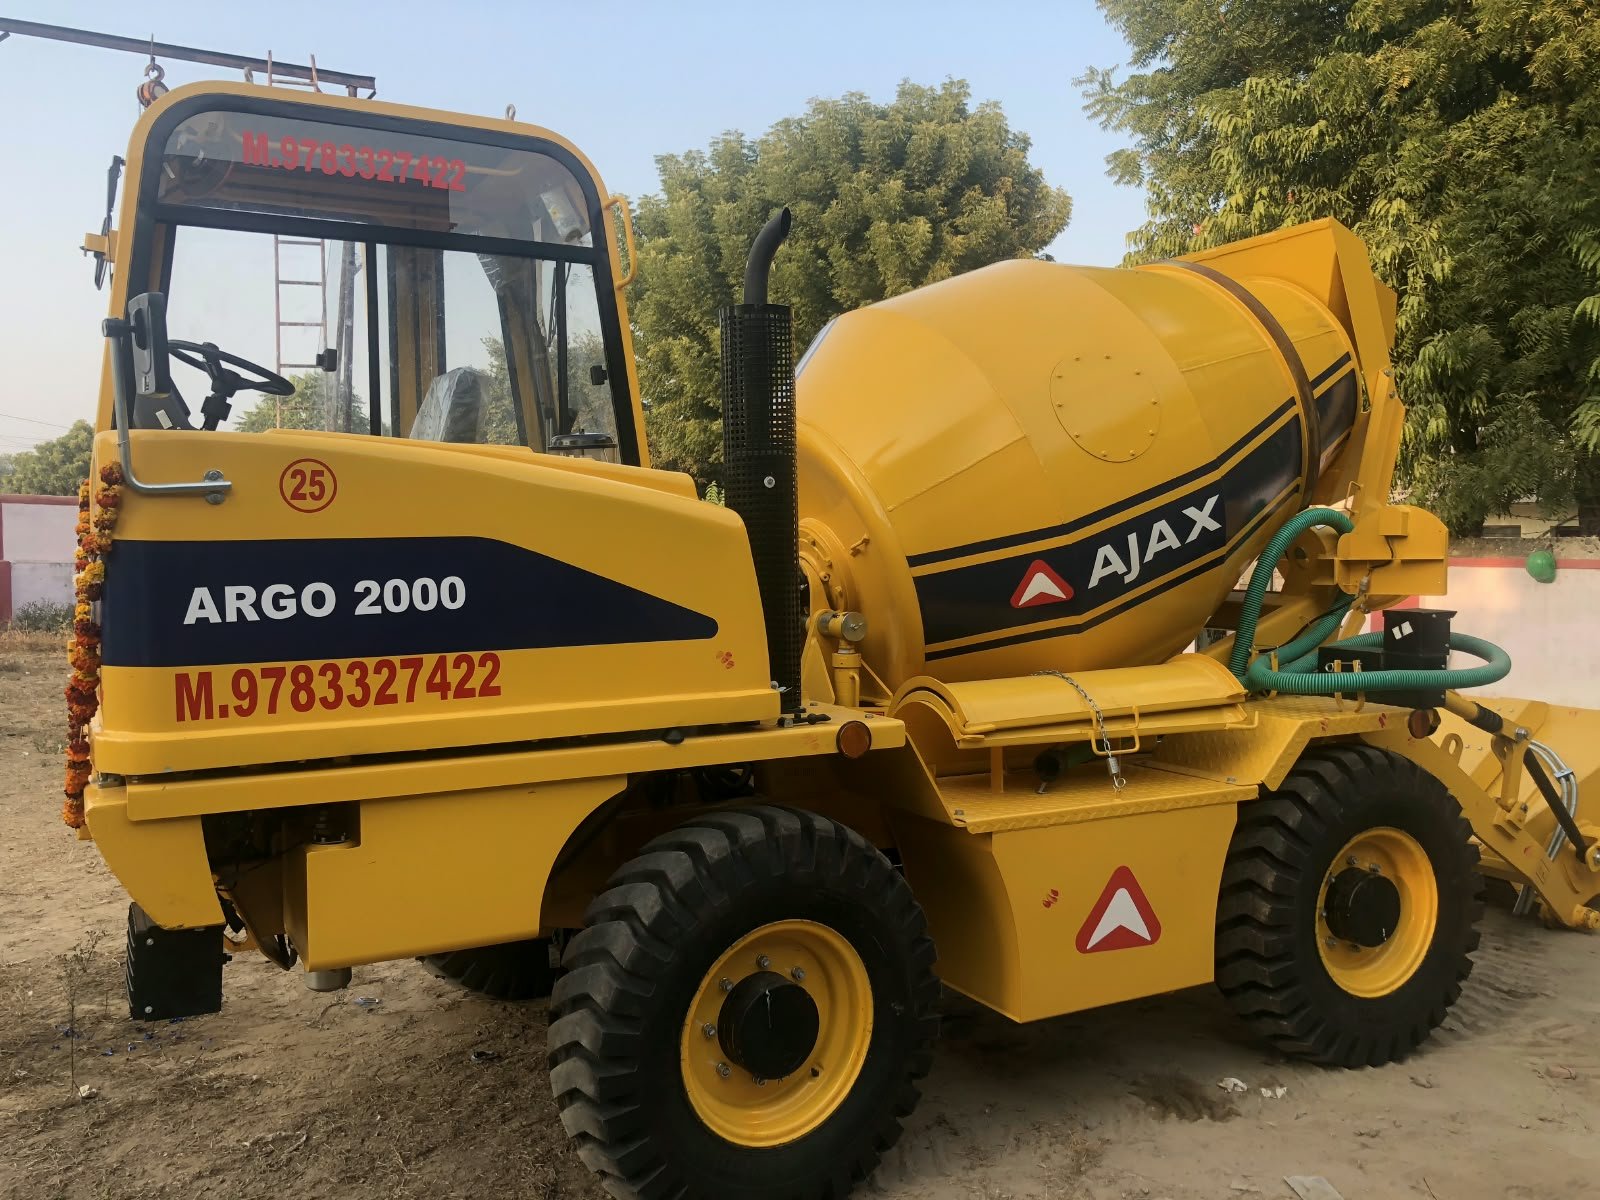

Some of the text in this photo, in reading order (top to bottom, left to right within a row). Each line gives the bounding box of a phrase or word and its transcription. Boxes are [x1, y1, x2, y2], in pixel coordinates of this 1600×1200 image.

[242, 131, 465, 192] M.9783327422
[290, 468, 326, 501] 25
[1087, 494, 1222, 590] AJAX
[183, 575, 466, 625] ARGO 2000
[175, 652, 502, 722] M.9783327422
